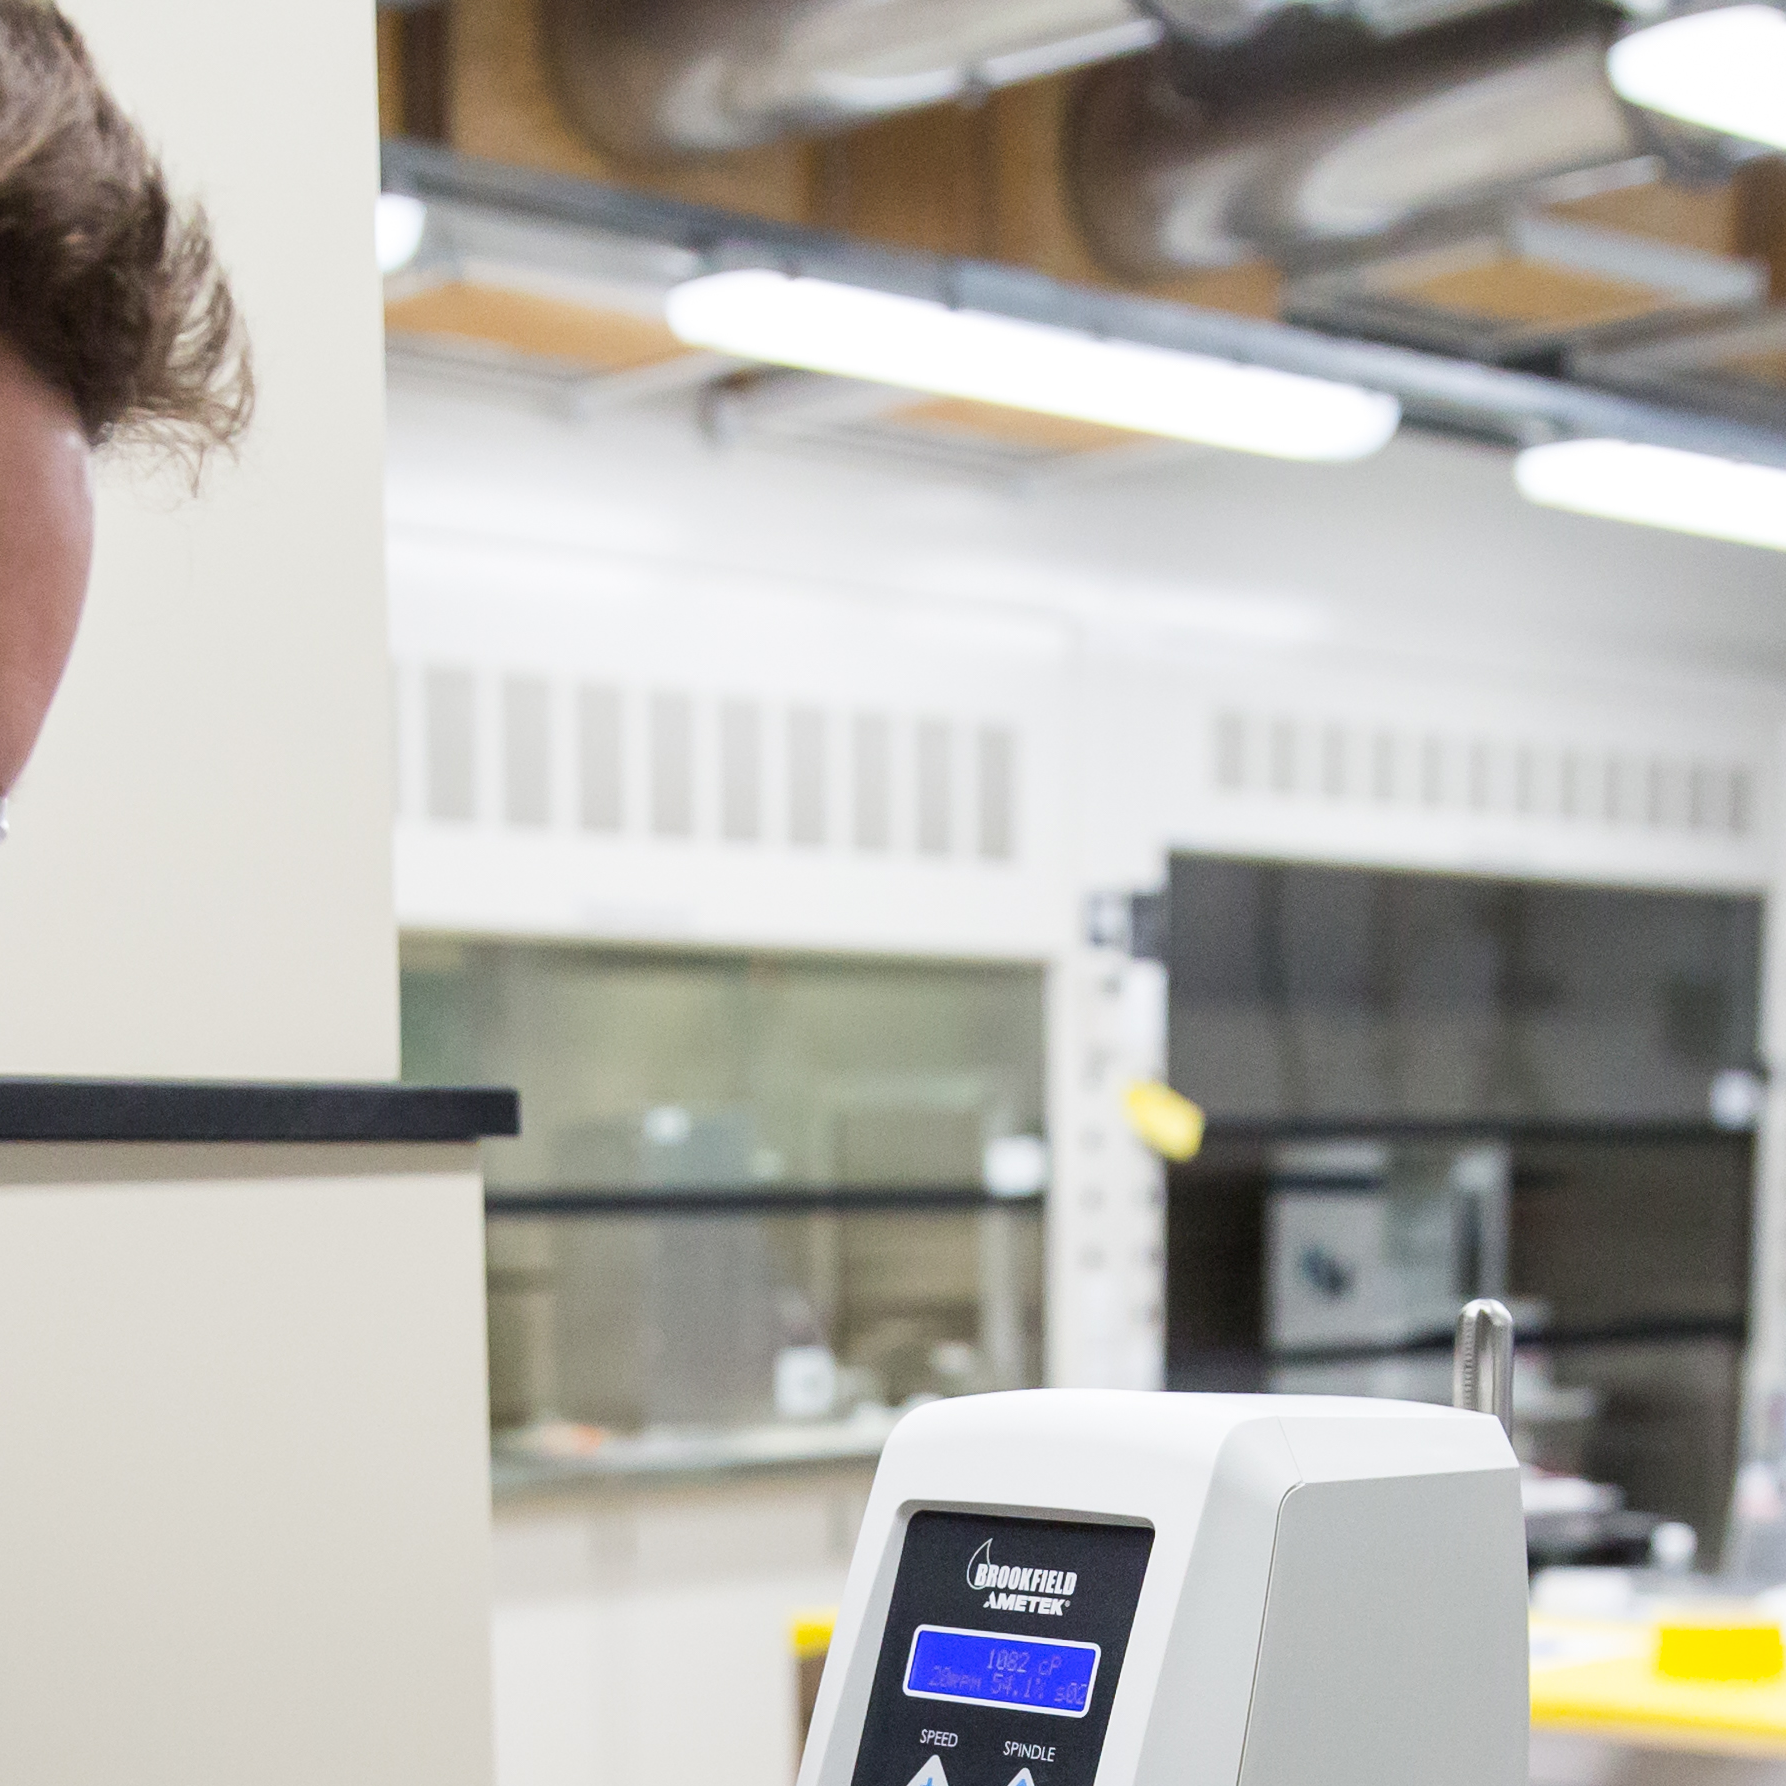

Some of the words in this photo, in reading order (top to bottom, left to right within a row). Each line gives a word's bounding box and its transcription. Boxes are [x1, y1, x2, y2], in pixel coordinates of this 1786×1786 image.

[974, 1563, 1077, 1595] BROOKFIELD
[983, 1591, 1066, 1616] AMETEK
[919, 1728, 959, 1748] SPEED
[1003, 1740, 1056, 1762] SPINDLE
